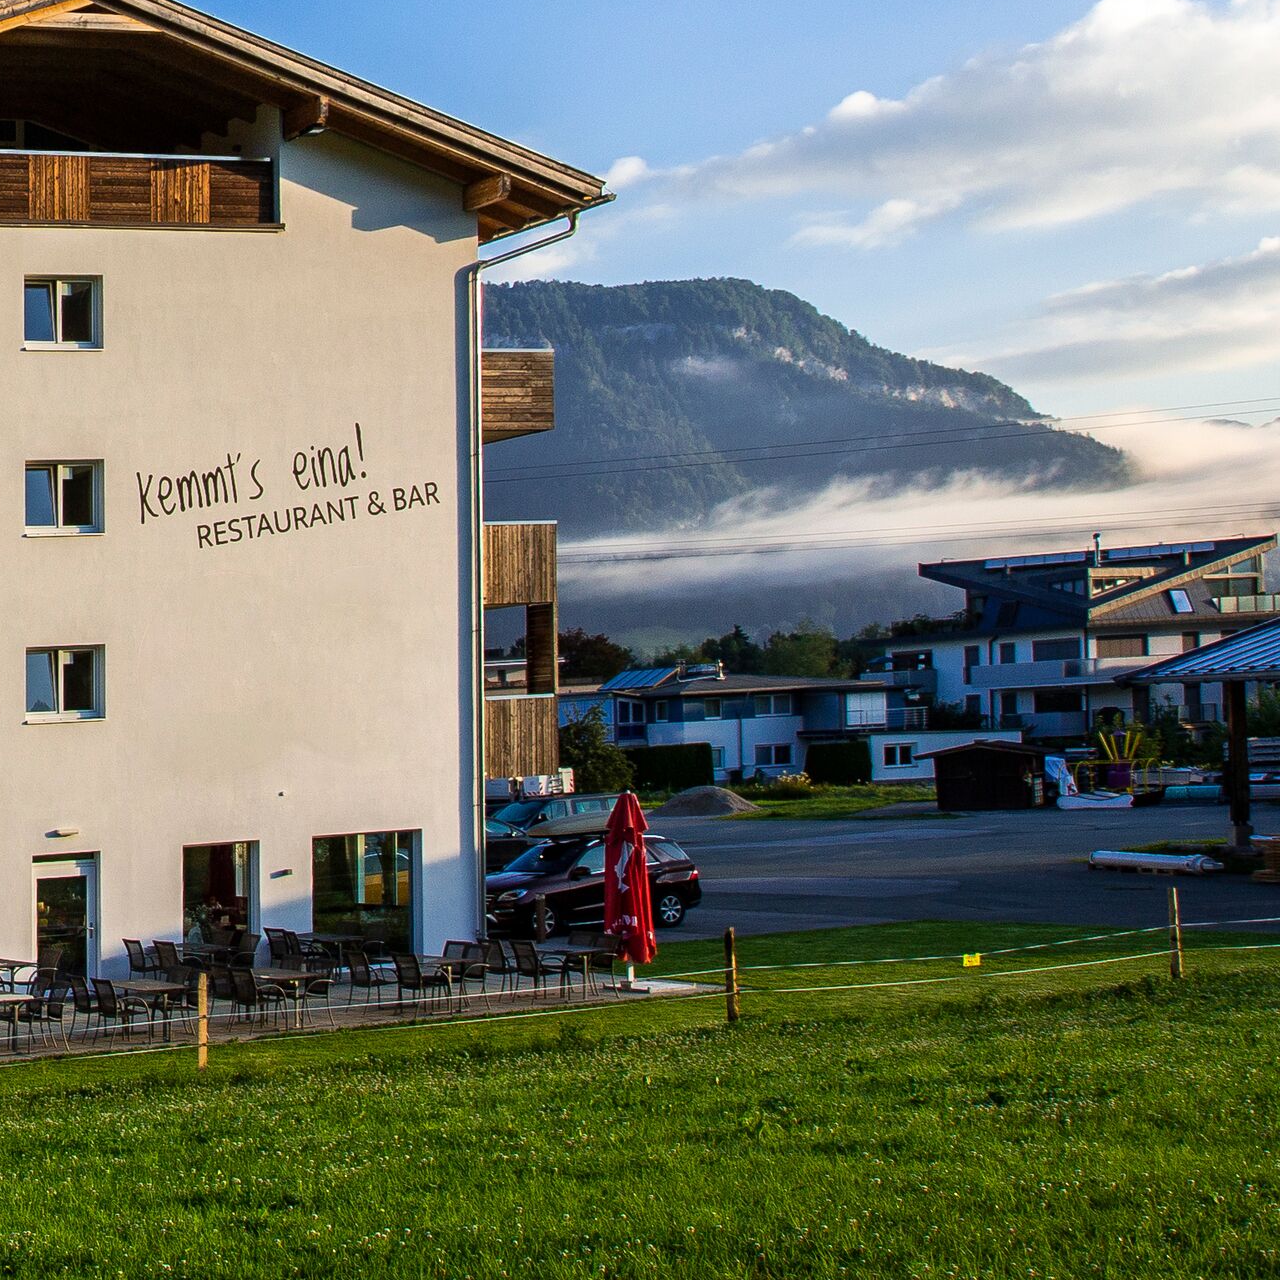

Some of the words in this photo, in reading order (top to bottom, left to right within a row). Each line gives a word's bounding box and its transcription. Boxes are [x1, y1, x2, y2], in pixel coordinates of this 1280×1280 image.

[292, 422, 367, 491] eina!
[196, 495, 360, 549] RESTAURANT
[367, 491, 387, 516] &
[392, 481, 441, 512] BAR
